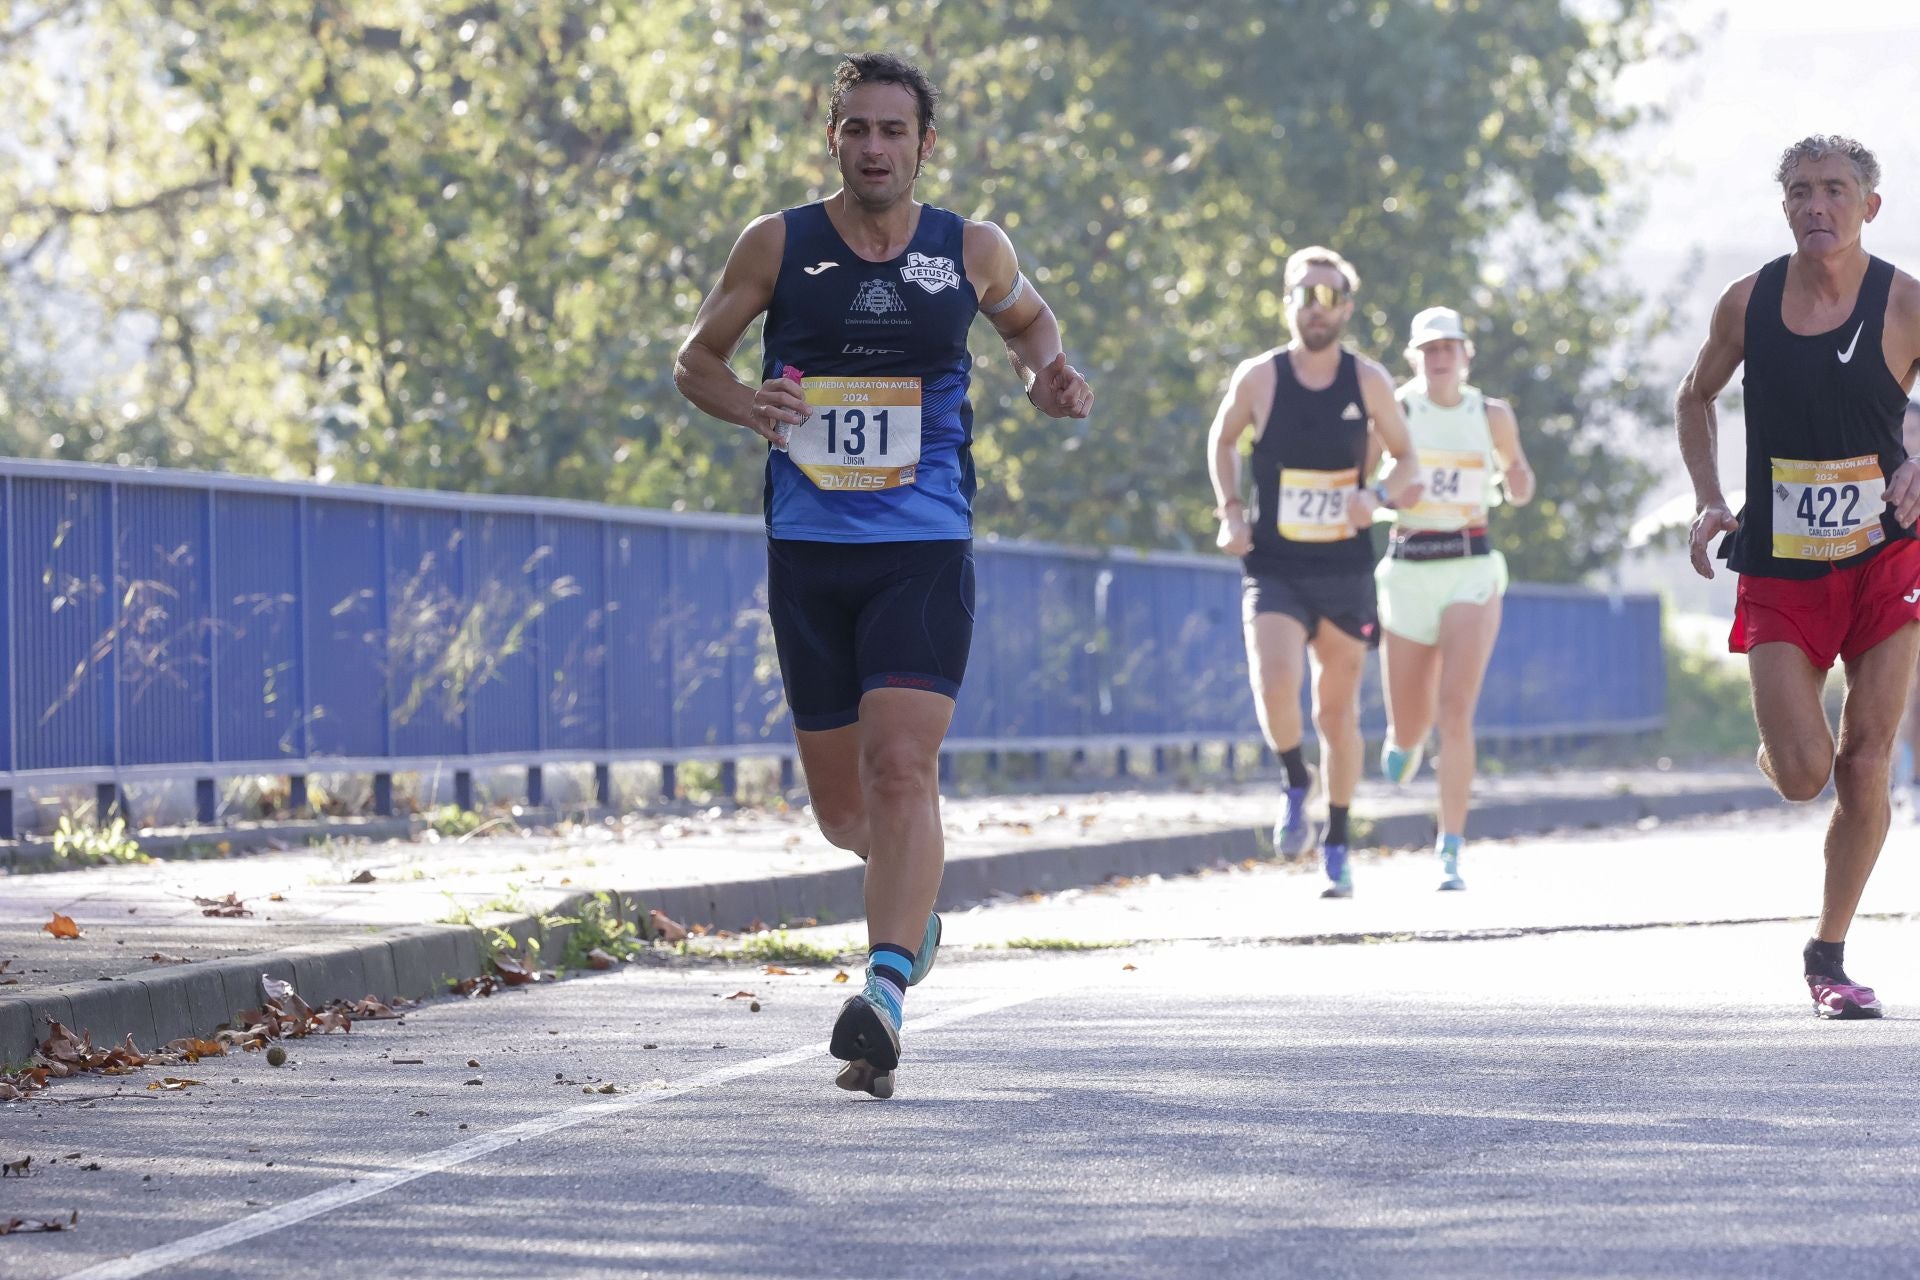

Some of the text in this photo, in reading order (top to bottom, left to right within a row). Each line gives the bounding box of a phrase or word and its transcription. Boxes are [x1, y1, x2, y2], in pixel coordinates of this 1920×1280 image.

[909, 268, 954, 283] VETUSTA
[819, 381, 845, 390] MEDIA
[847, 379, 889, 390] MARATÓN
[890, 379, 919, 390] AVILÉS
[842, 393, 869, 402] 2024
[820, 408, 889, 456] 131
[1431, 468, 1459, 496] 84
[1815, 473, 1839, 482] 2024
[1299, 489, 1342, 518] 279
[1796, 485, 1860, 527] 422
[1808, 527, 1850, 537] CARLOS DAVID
